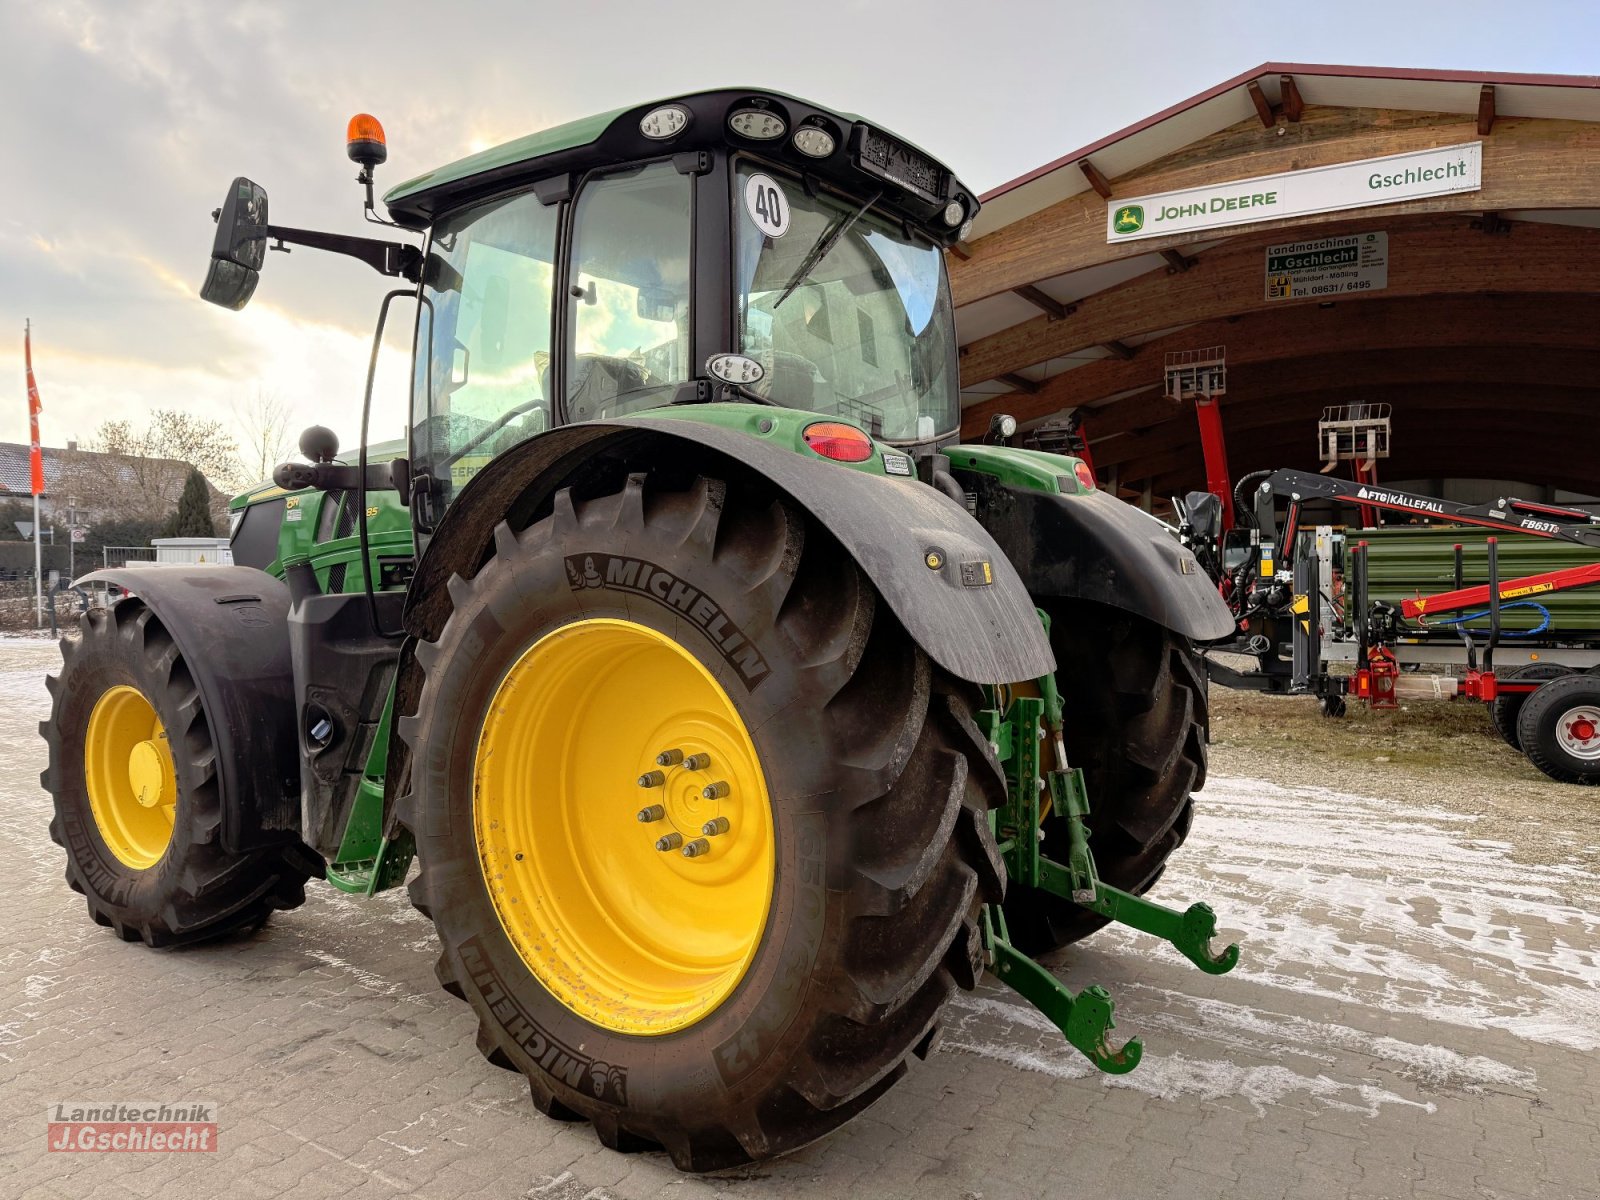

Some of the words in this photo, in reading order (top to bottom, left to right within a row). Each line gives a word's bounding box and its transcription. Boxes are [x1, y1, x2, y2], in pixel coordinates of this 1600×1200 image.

[1368, 159, 1467, 190] Gschlecht
[755, 184, 781, 228] 40
[1155, 201, 1206, 222] JOHN
[1210, 191, 1277, 213] DEERE
[1268, 237, 1358, 255] Landmaschinen
[1271, 260, 1282, 270] J.
[1285, 250, 1355, 268] Gschlecht
[1292, 288, 1308, 297] Tel.
[1311, 284, 1338, 295] 08631
[1346, 280, 1371, 290] 6495
[606, 557, 767, 681] MICHELIN
[458, 944, 588, 1088] MICHELIN
